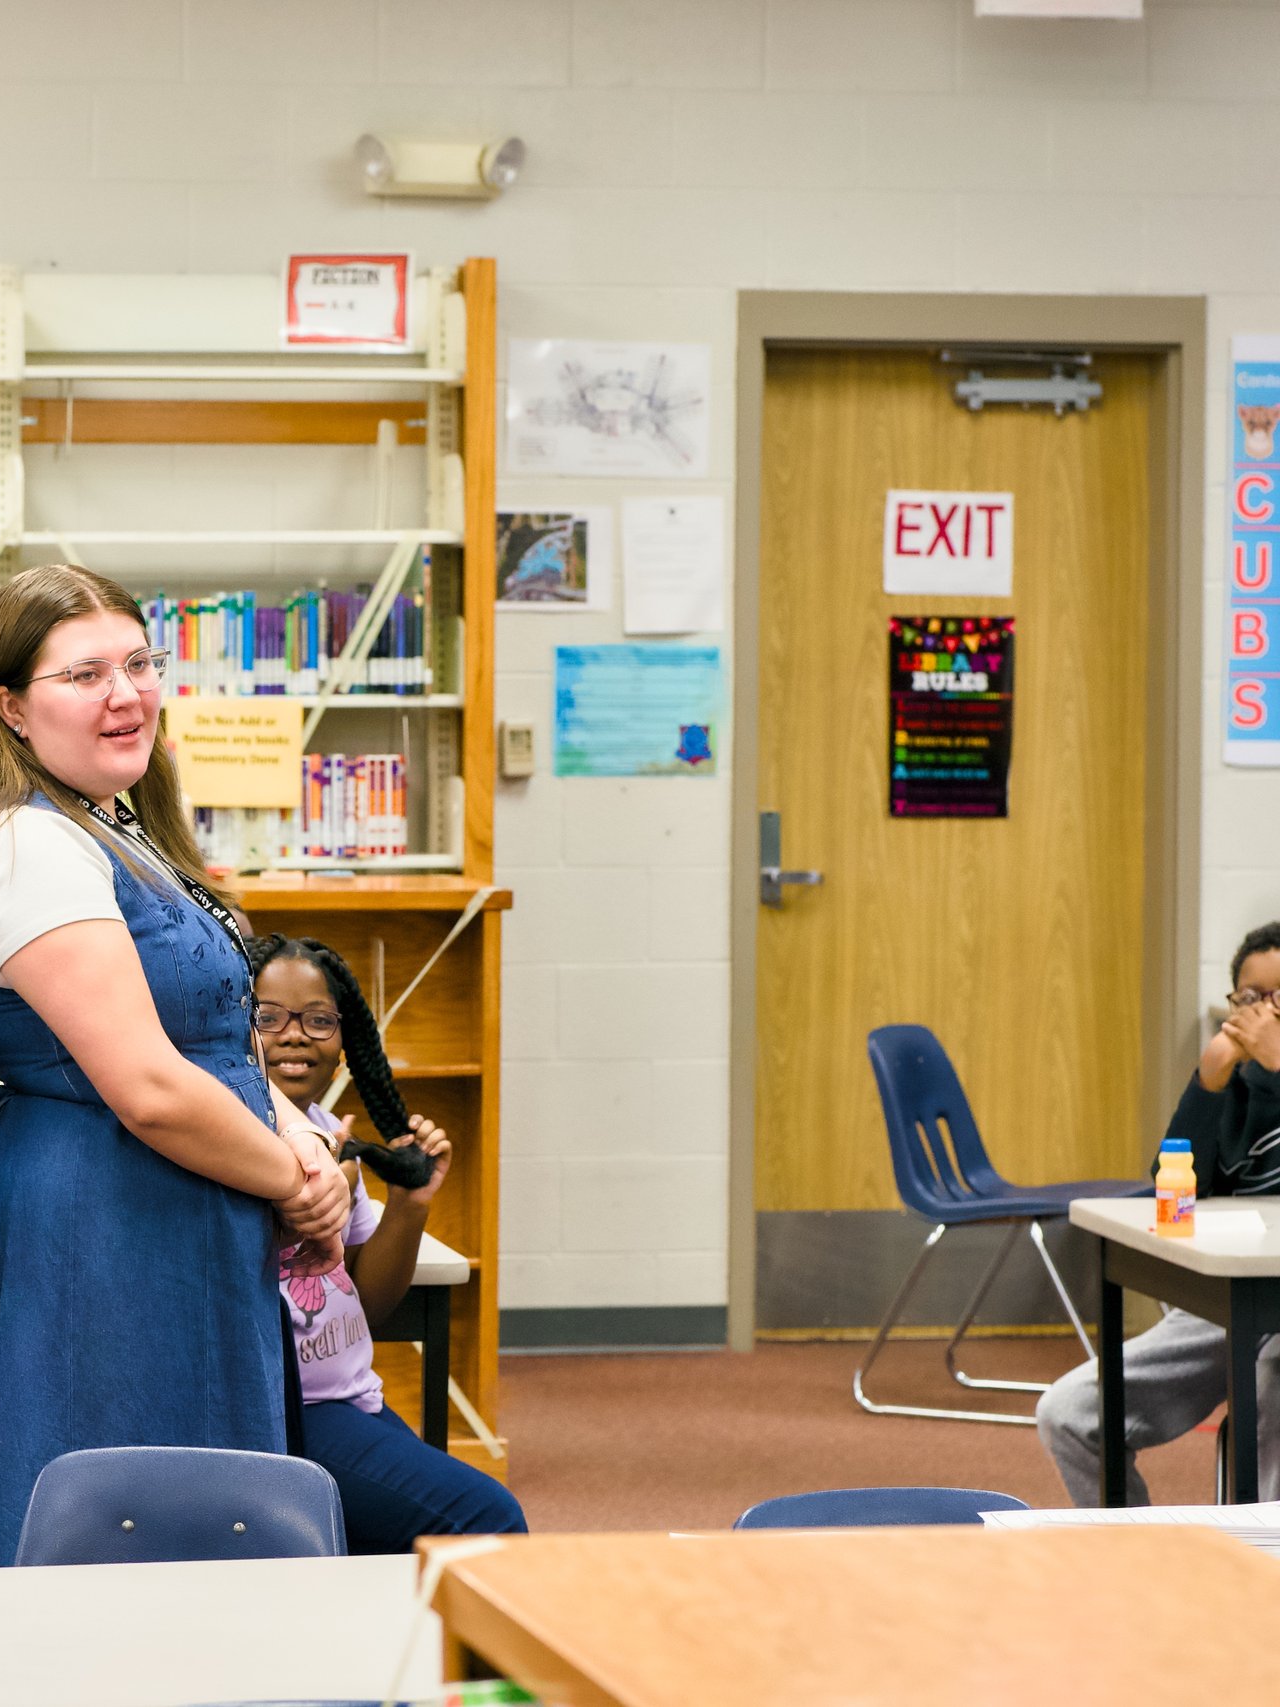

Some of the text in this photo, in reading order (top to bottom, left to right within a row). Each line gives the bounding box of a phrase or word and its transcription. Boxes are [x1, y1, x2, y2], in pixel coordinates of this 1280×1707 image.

[895, 503, 1005, 558] EXIT
[898, 652, 1003, 673] LIBRARY
[911, 671, 989, 692] RULES
[239, 714, 261, 726] Add
[183, 734, 290, 747] Remove any books
[192, 752, 245, 765] Inventory
[91, 806, 115, 825] City
[192, 889, 227, 920] City of
[300, 1317, 339, 1364] self
